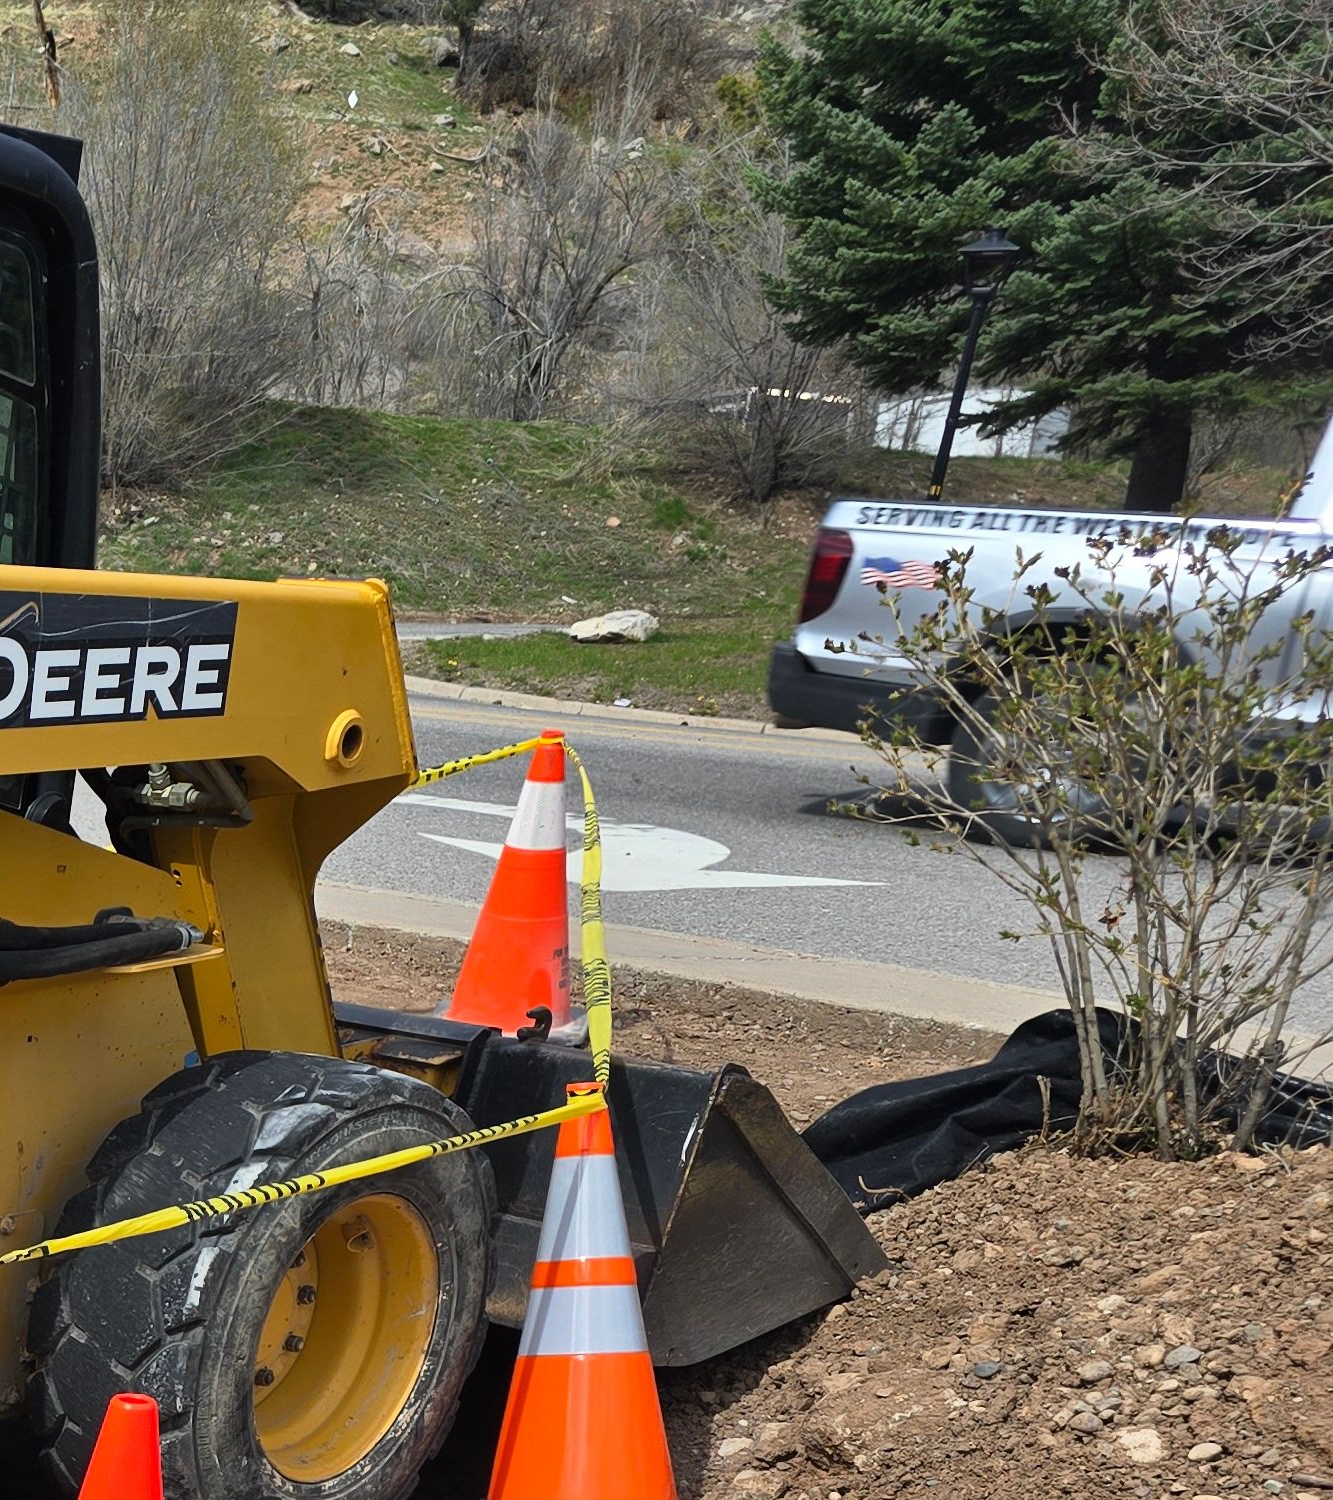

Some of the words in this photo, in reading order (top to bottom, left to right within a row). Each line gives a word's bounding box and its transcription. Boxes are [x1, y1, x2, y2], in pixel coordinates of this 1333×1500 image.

[856, 506, 964, 529] SERVING
[968, 512, 1011, 531] ALL
[1017, 514, 1067, 534] THE
